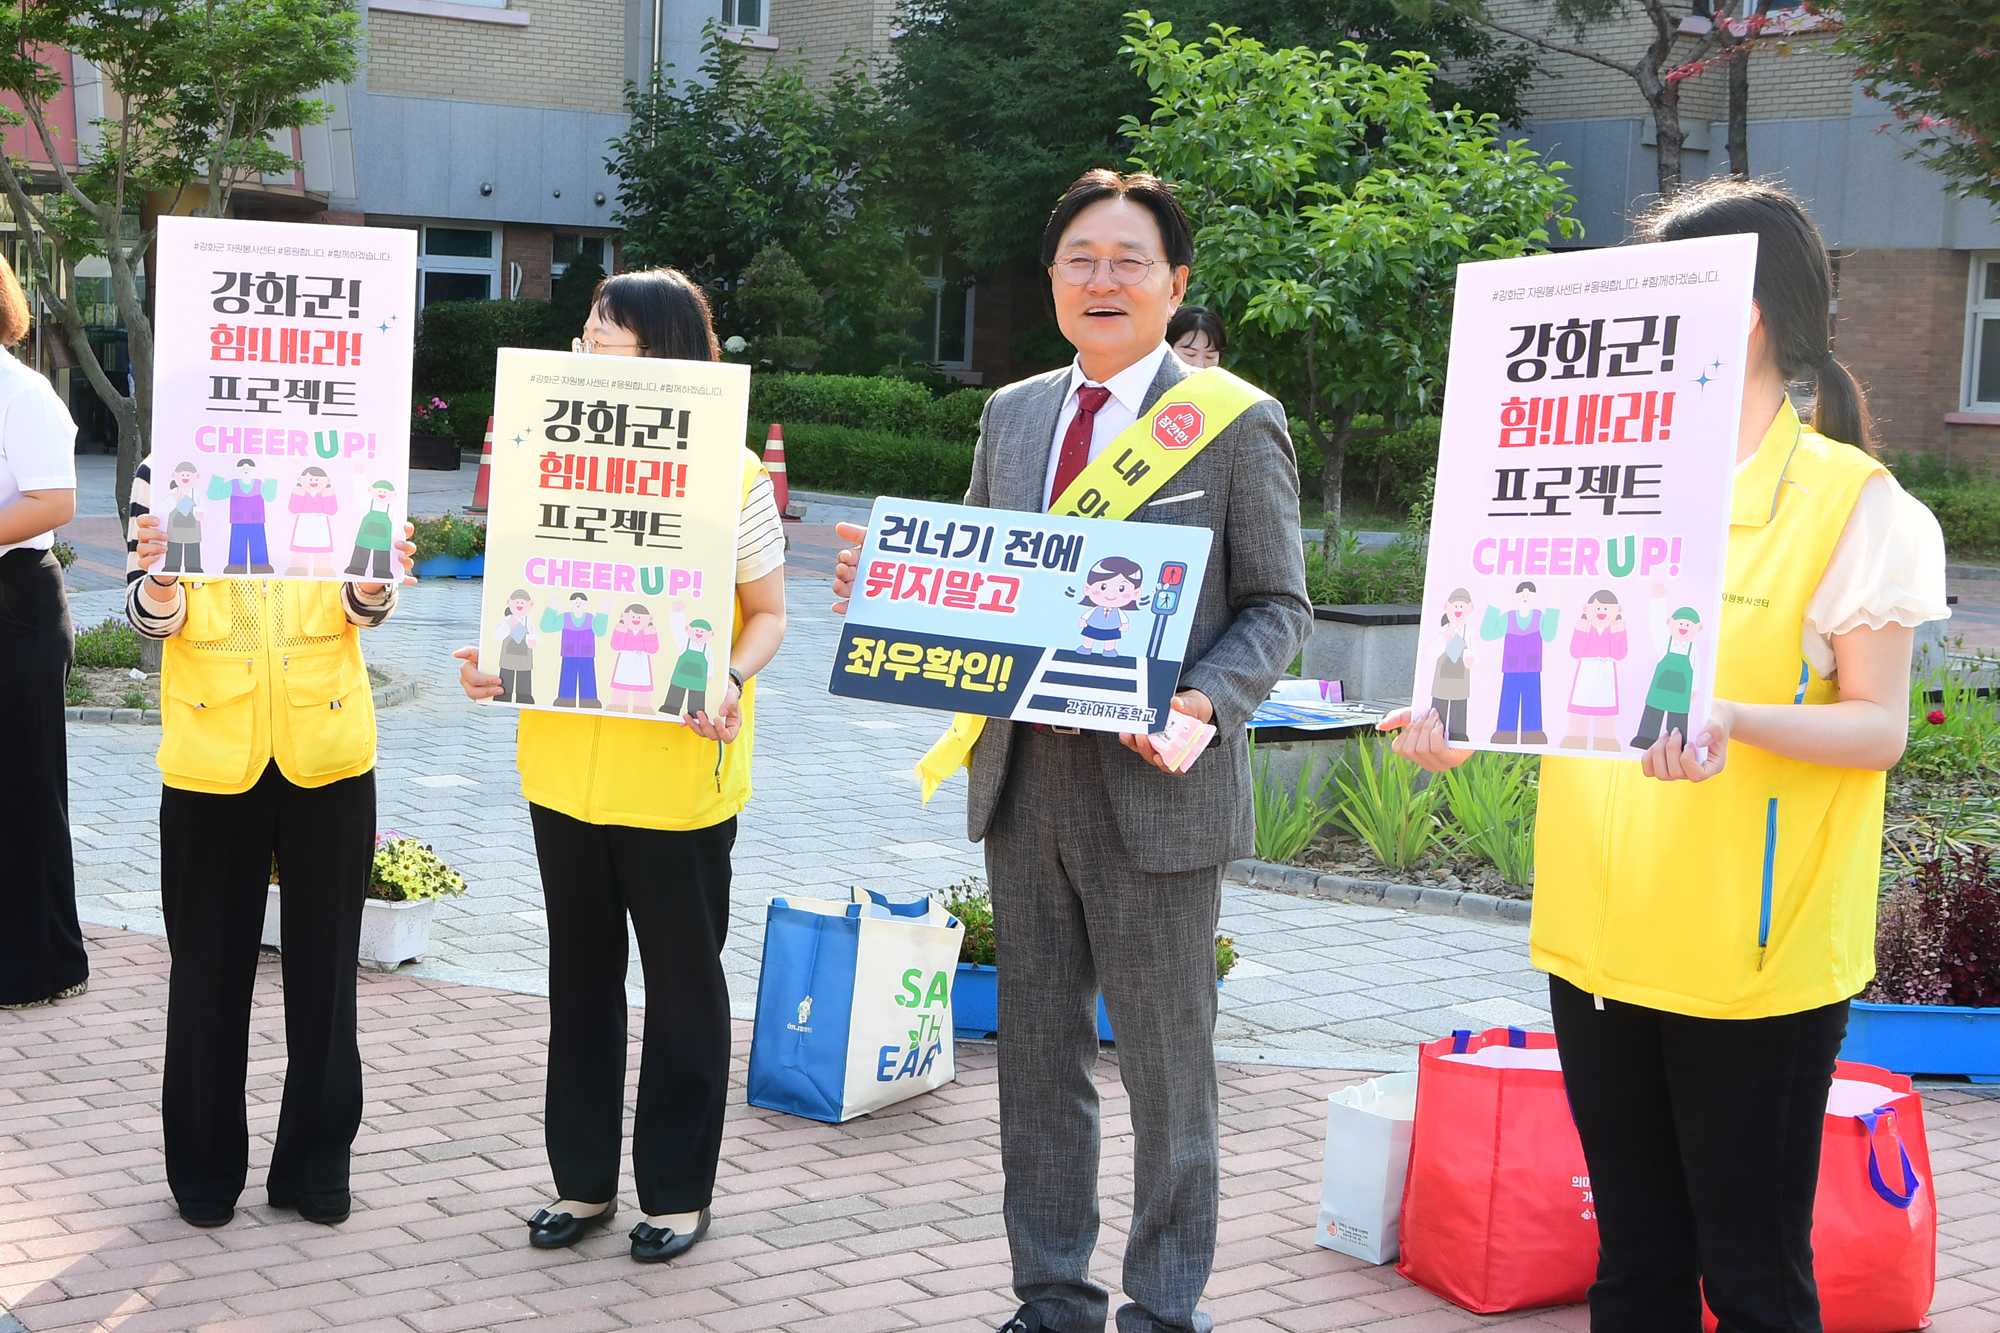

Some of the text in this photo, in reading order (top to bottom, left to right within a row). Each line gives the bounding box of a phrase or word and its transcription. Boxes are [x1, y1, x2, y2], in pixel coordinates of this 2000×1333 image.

[193, 242, 392, 262] #강화군 자원봉사센터 #응원합니다. #함께하겠습니다.
[210, 271, 362, 319] 강화군!
[1492, 269, 1720, 302] #강화군 자원봉사센터 #응원합니다. #함께하겠습니다.
[209, 323, 363, 367] 힘!내!라!
[1505, 315, 1681, 383] 강화군!
[205, 375, 358, 417] 프로젝트
[530, 374, 724, 397] #강화군 자원봉사센터 #응원합니다. #함께하겠습니다.
[543, 399, 691, 450] 강화군!
[1157, 415, 1189, 445] 잠깐만
[1497, 391, 1676, 448] 힘!내!라!
[538, 451, 689, 498] 힘!내!라!
[1487, 464, 1663, 517] 프로젝트
[534, 503, 683, 549] 프로젝트
[878, 515, 1084, 573] 건너기 전에
[865, 561, 1020, 614] 뛰지말고
[844, 636, 1014, 693] 좌우확인!
[1066, 701, 1156, 723] 강화여자중학교
